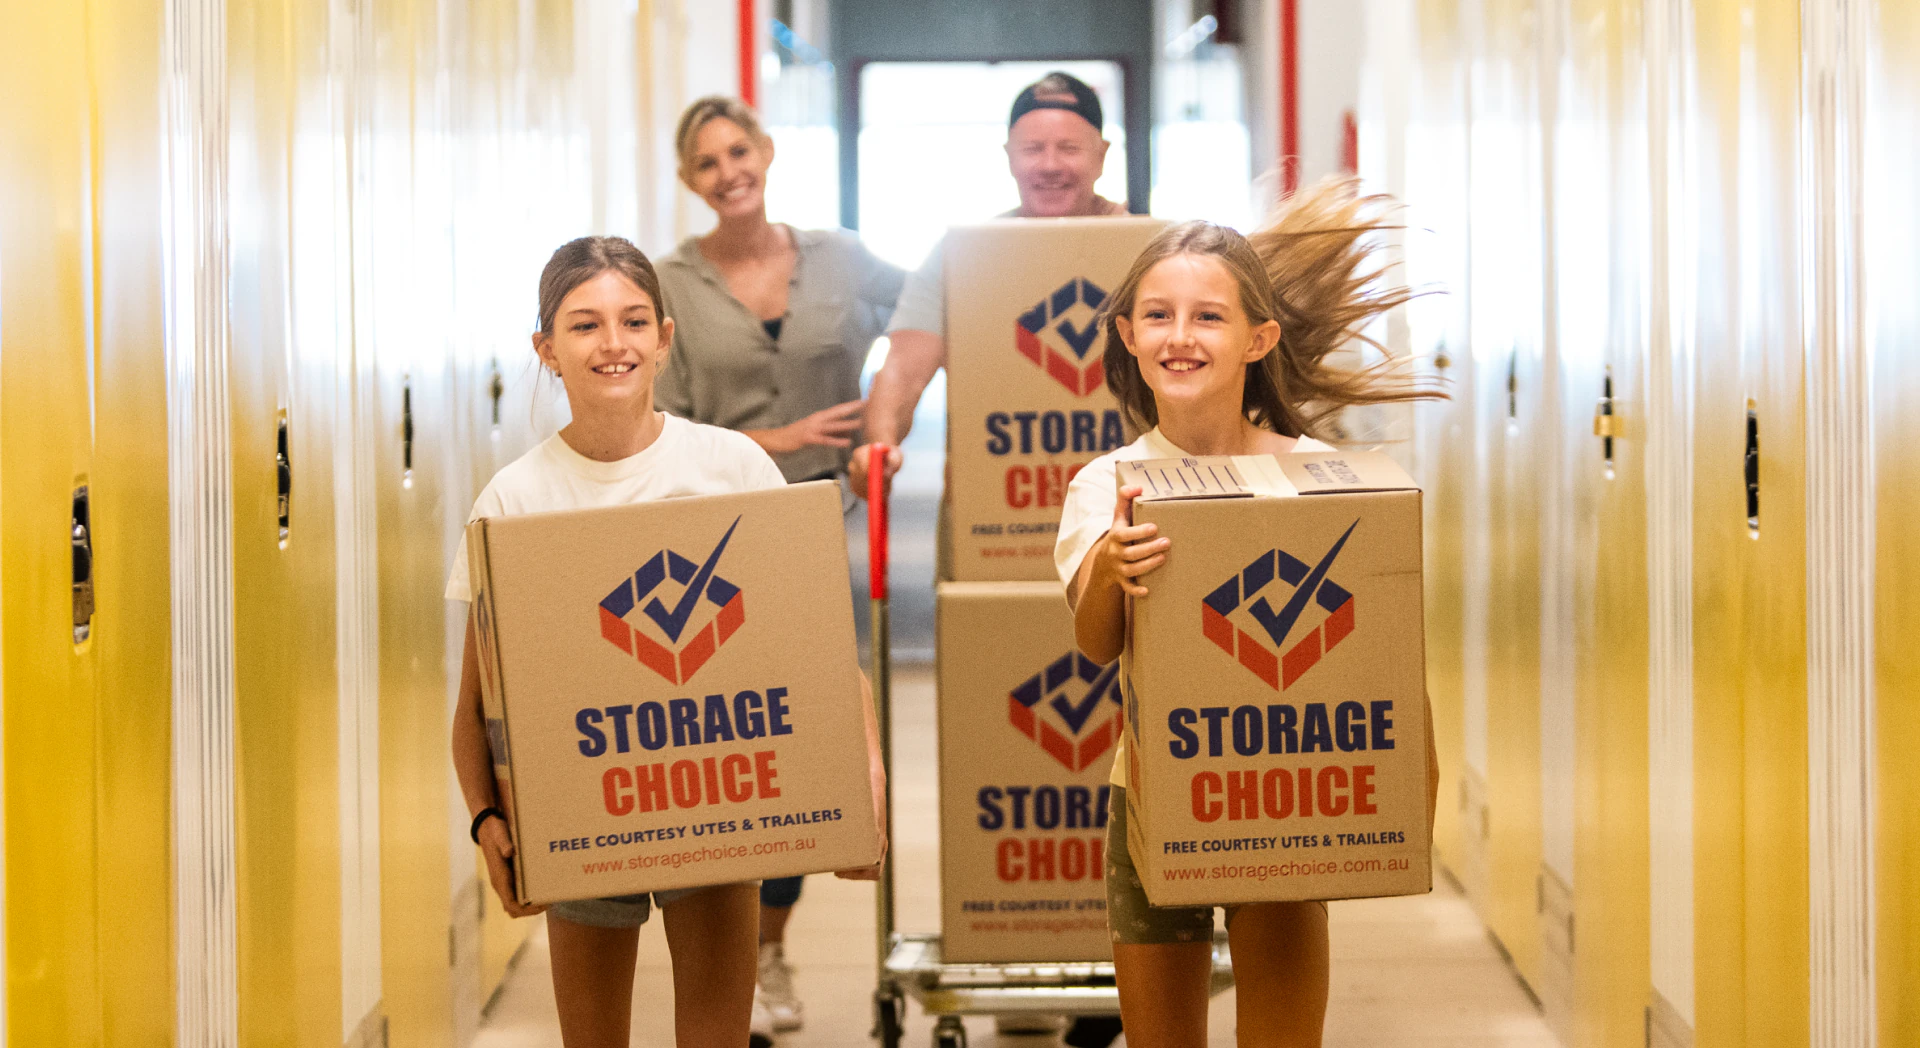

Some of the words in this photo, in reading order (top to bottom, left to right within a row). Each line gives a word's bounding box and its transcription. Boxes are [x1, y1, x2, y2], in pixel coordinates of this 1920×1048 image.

[986, 410, 1124, 456] STORA
[575, 687, 793, 758] STORAGE
[1168, 700, 1395, 759] STORAGE
[602, 750, 781, 817] CHOICE
[1191, 765, 1377, 823] CHOICE
[549, 836, 590, 853] FREE
[595, 826, 686, 848] COURTESY
[692, 820, 736, 836] UTES
[742, 818, 753, 831] &
[759, 808, 843, 829] TRAILERS
[977, 784, 1110, 831] STORA
[582, 837, 816, 875] www.storagechoice.com.au
[997, 836, 1104, 883] CHOI
[1164, 841, 1197, 854] FREE
[1202, 837, 1277, 852] COURTESY
[1282, 835, 1318, 848] UTES
[1322, 835, 1332, 847] &
[1336, 831, 1405, 846] TRAILERS
[1164, 857, 1409, 881] www.storagechoice.com.au
